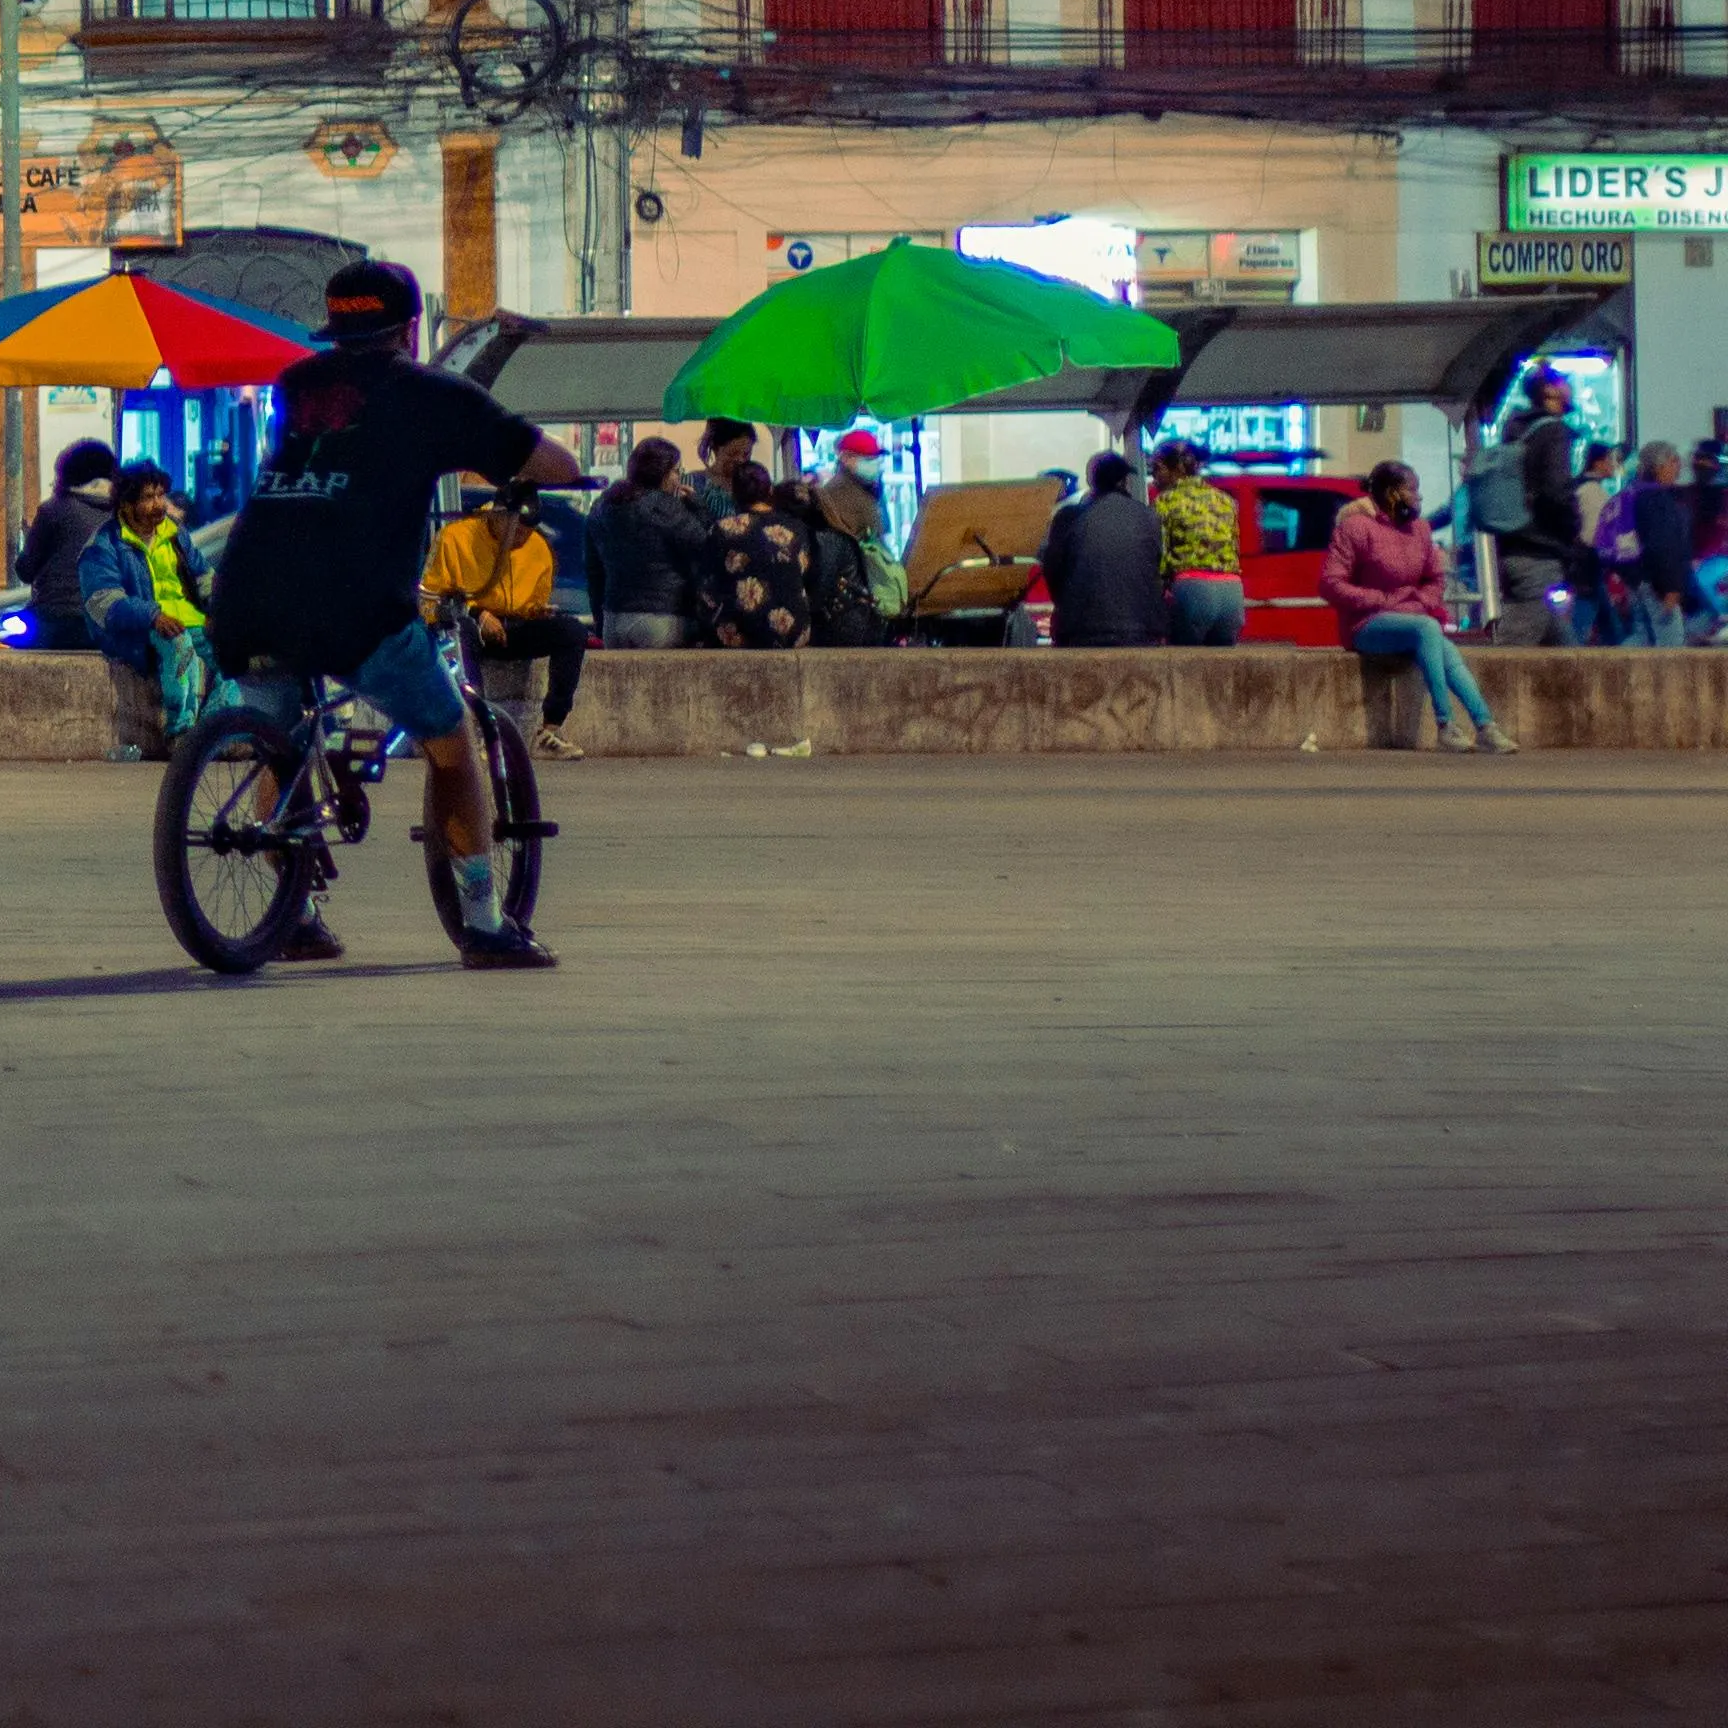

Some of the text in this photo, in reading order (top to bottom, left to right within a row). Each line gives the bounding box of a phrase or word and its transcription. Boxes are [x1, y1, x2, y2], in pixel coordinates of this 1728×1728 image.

[1528, 209, 1637, 225] HECHURA
[1488, 241, 1623, 273] COMPRO ORO
